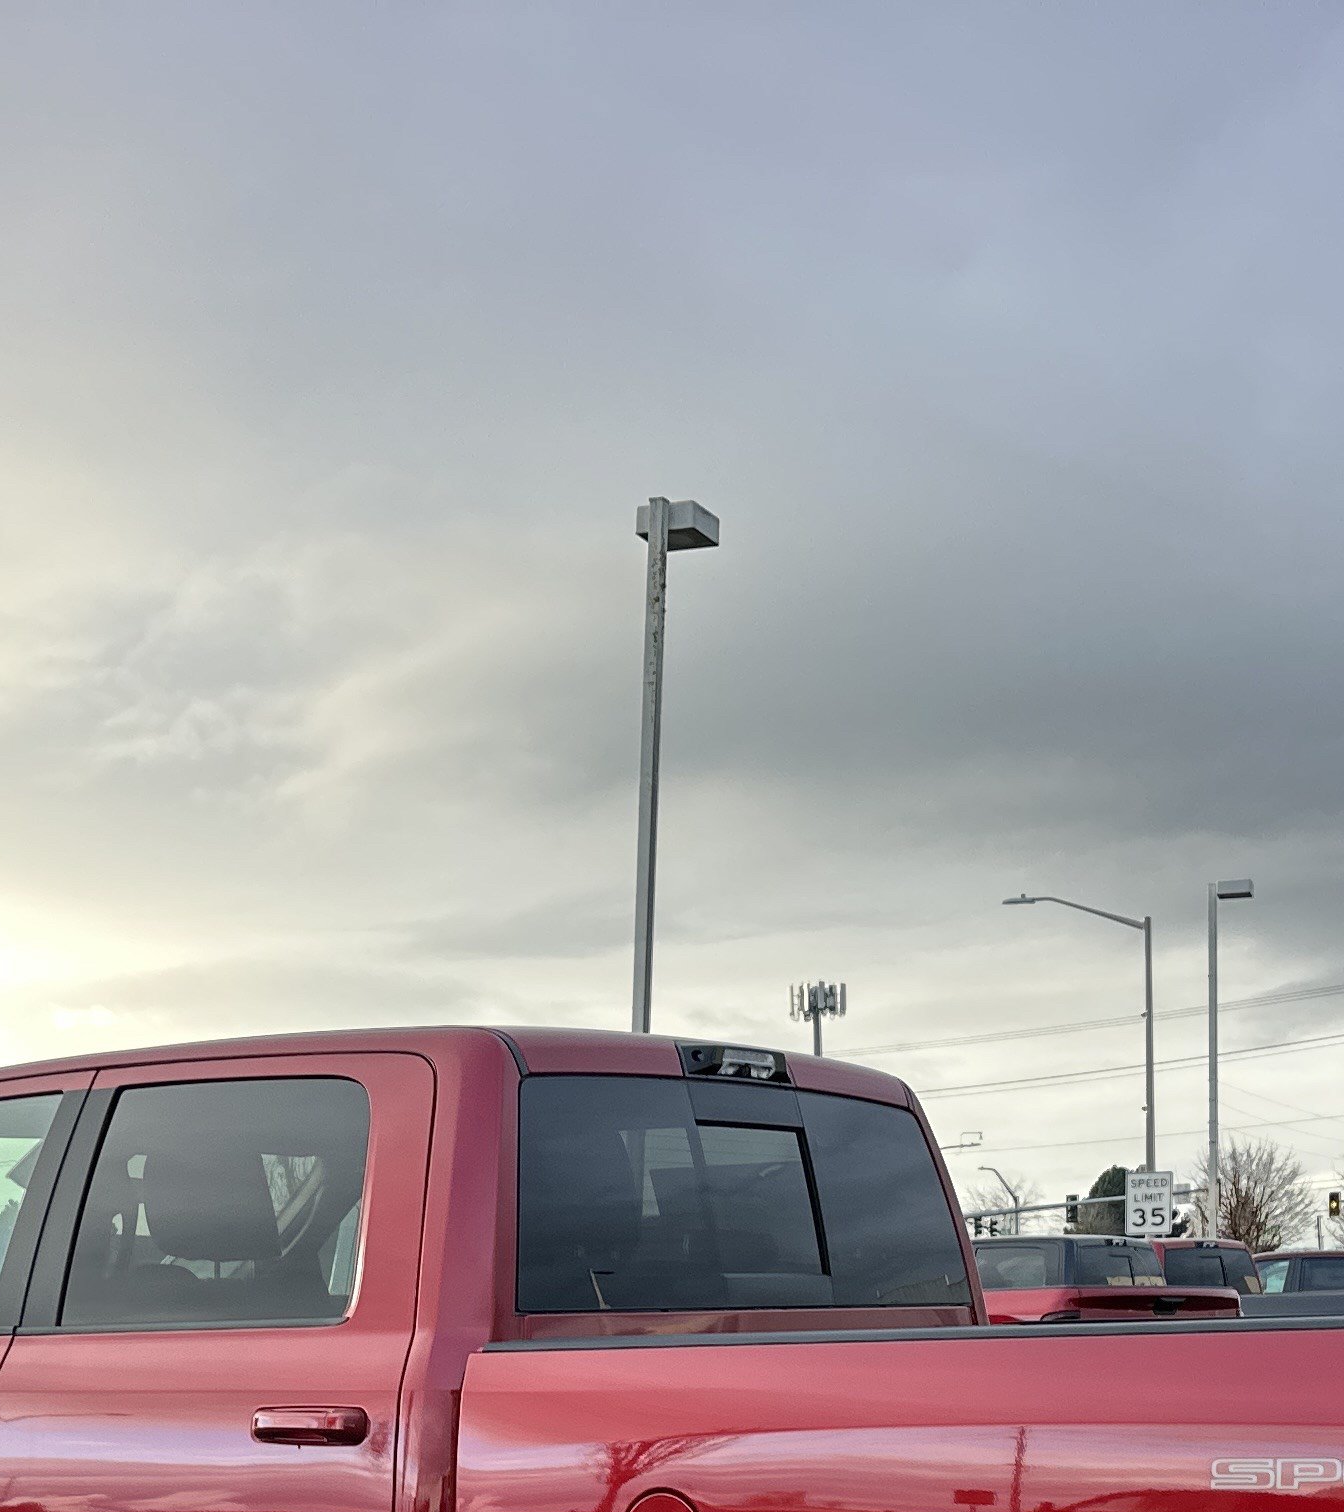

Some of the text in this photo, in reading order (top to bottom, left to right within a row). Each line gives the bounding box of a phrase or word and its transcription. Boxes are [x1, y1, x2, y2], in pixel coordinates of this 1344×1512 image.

[1131, 1178, 1168, 1188] SPEED
[1134, 1193, 1164, 1202] LIMIT
[1132, 1208, 1165, 1226] 35
